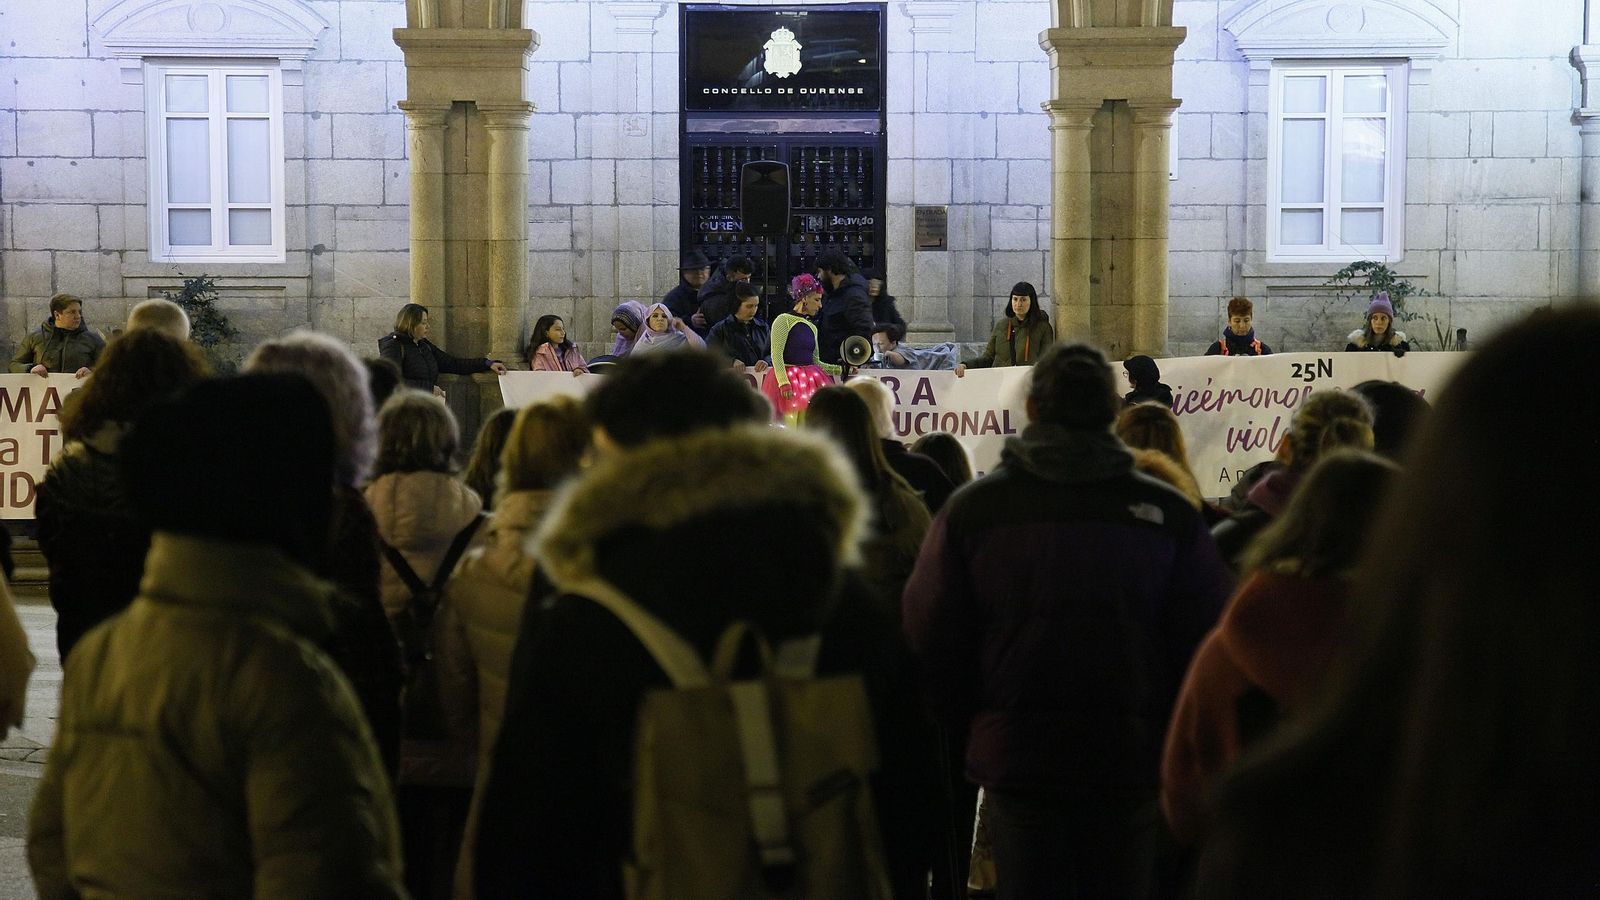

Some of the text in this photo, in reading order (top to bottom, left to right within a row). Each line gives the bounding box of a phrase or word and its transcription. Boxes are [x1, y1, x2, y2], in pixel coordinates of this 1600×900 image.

[699, 221, 743, 231] OUREN
[1291, 358, 1333, 382] 25N
[0, 387, 74, 423] MA
[911, 377, 936, 405] A
[1170, 377, 1313, 416] icémono
[892, 409, 1017, 437] UCIONAL
[1226, 415, 1290, 453] viol
